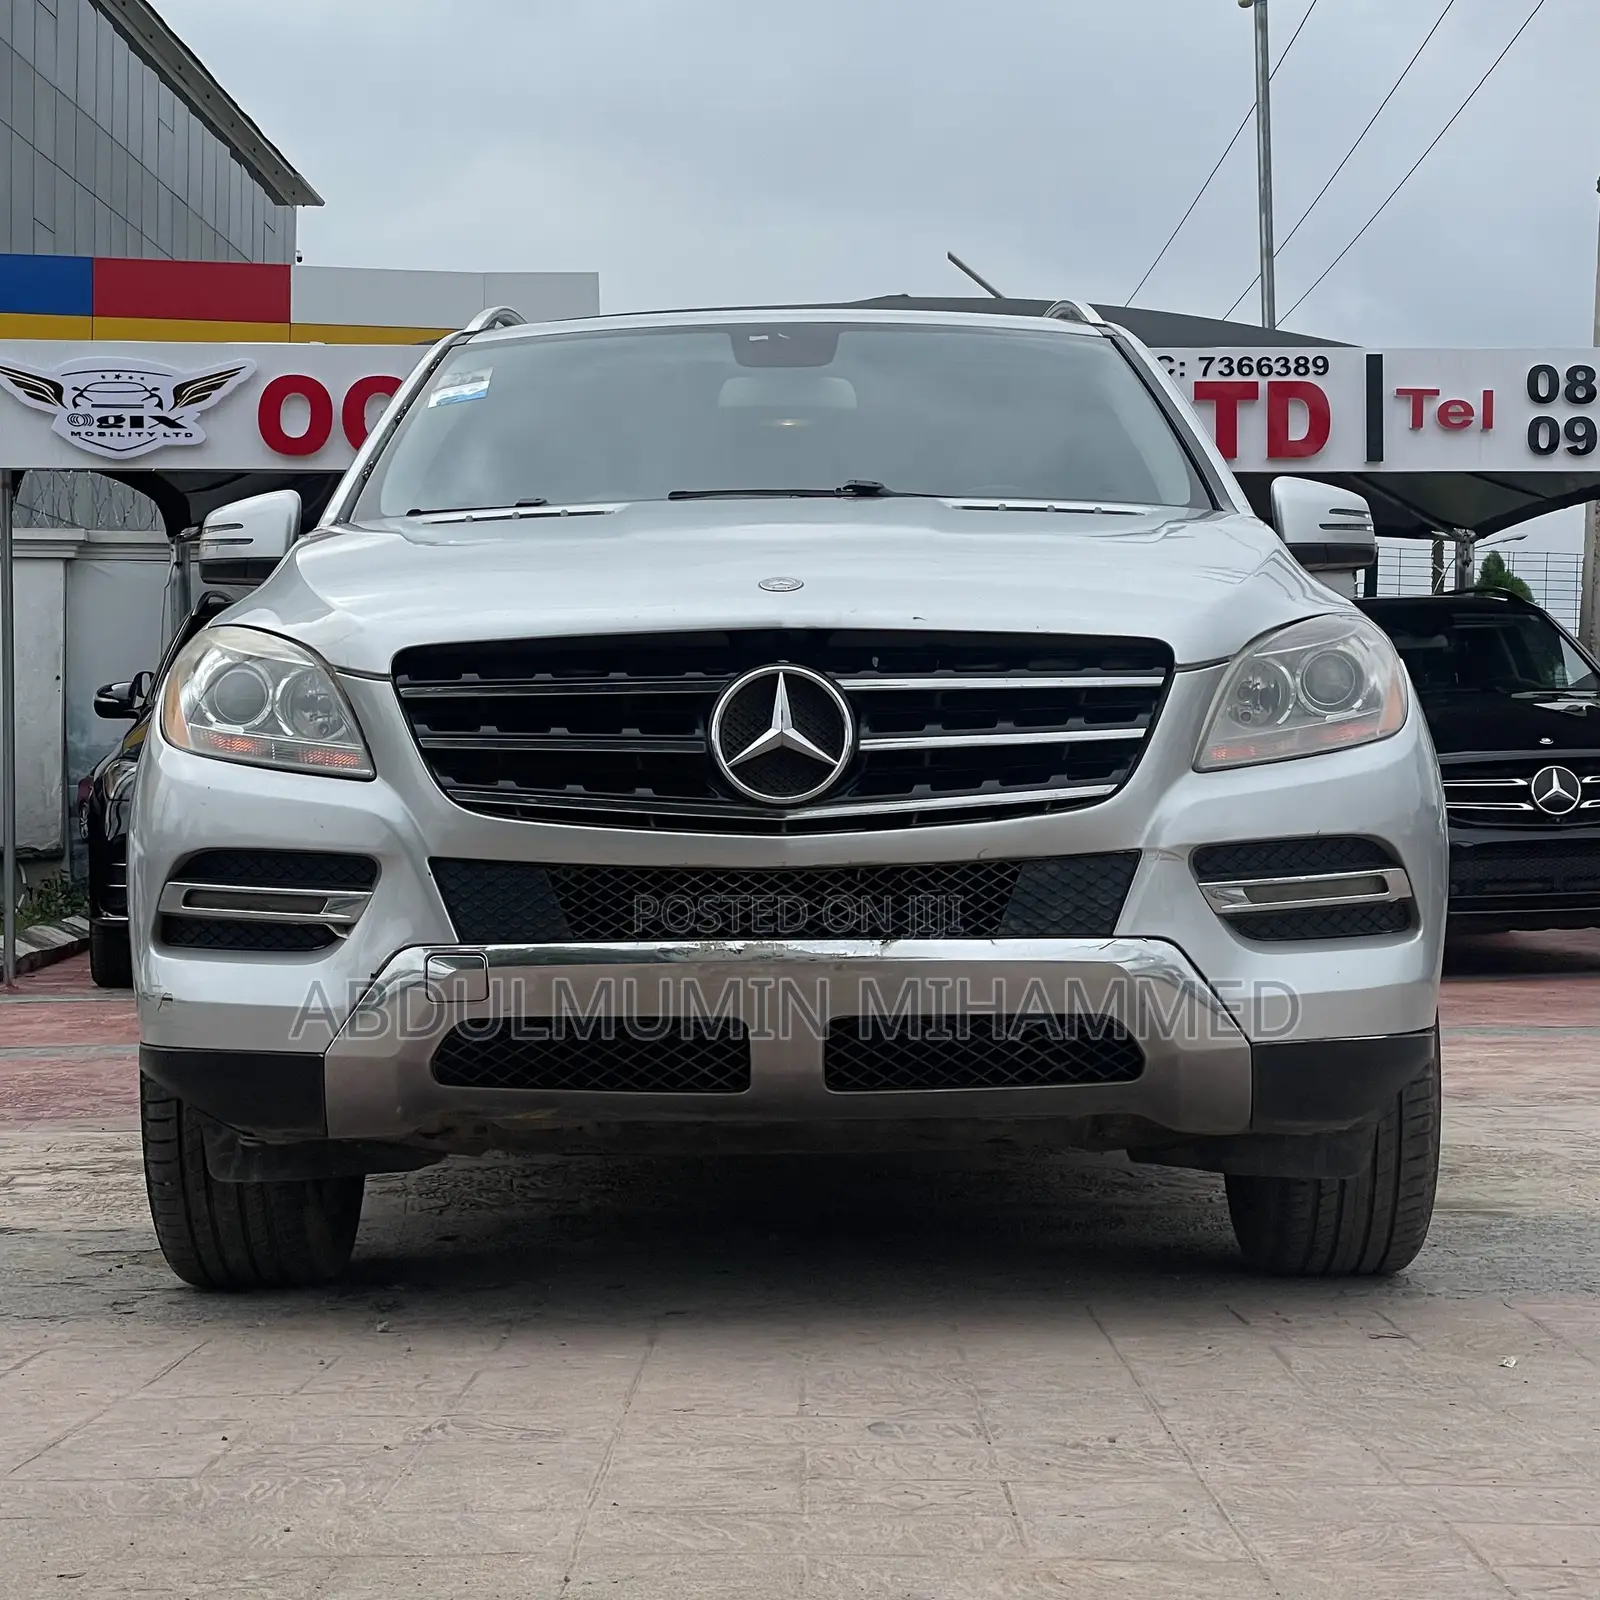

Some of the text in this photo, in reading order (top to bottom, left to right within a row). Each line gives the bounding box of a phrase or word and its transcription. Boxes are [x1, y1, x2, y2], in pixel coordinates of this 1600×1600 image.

[1198, 355, 1330, 377] 7366389
[1526, 363, 1598, 404] 08
[1395, 388, 1494, 430] Tel
[70, 430, 156, 438] MOBILITY
[1526, 415, 1598, 456] 09
